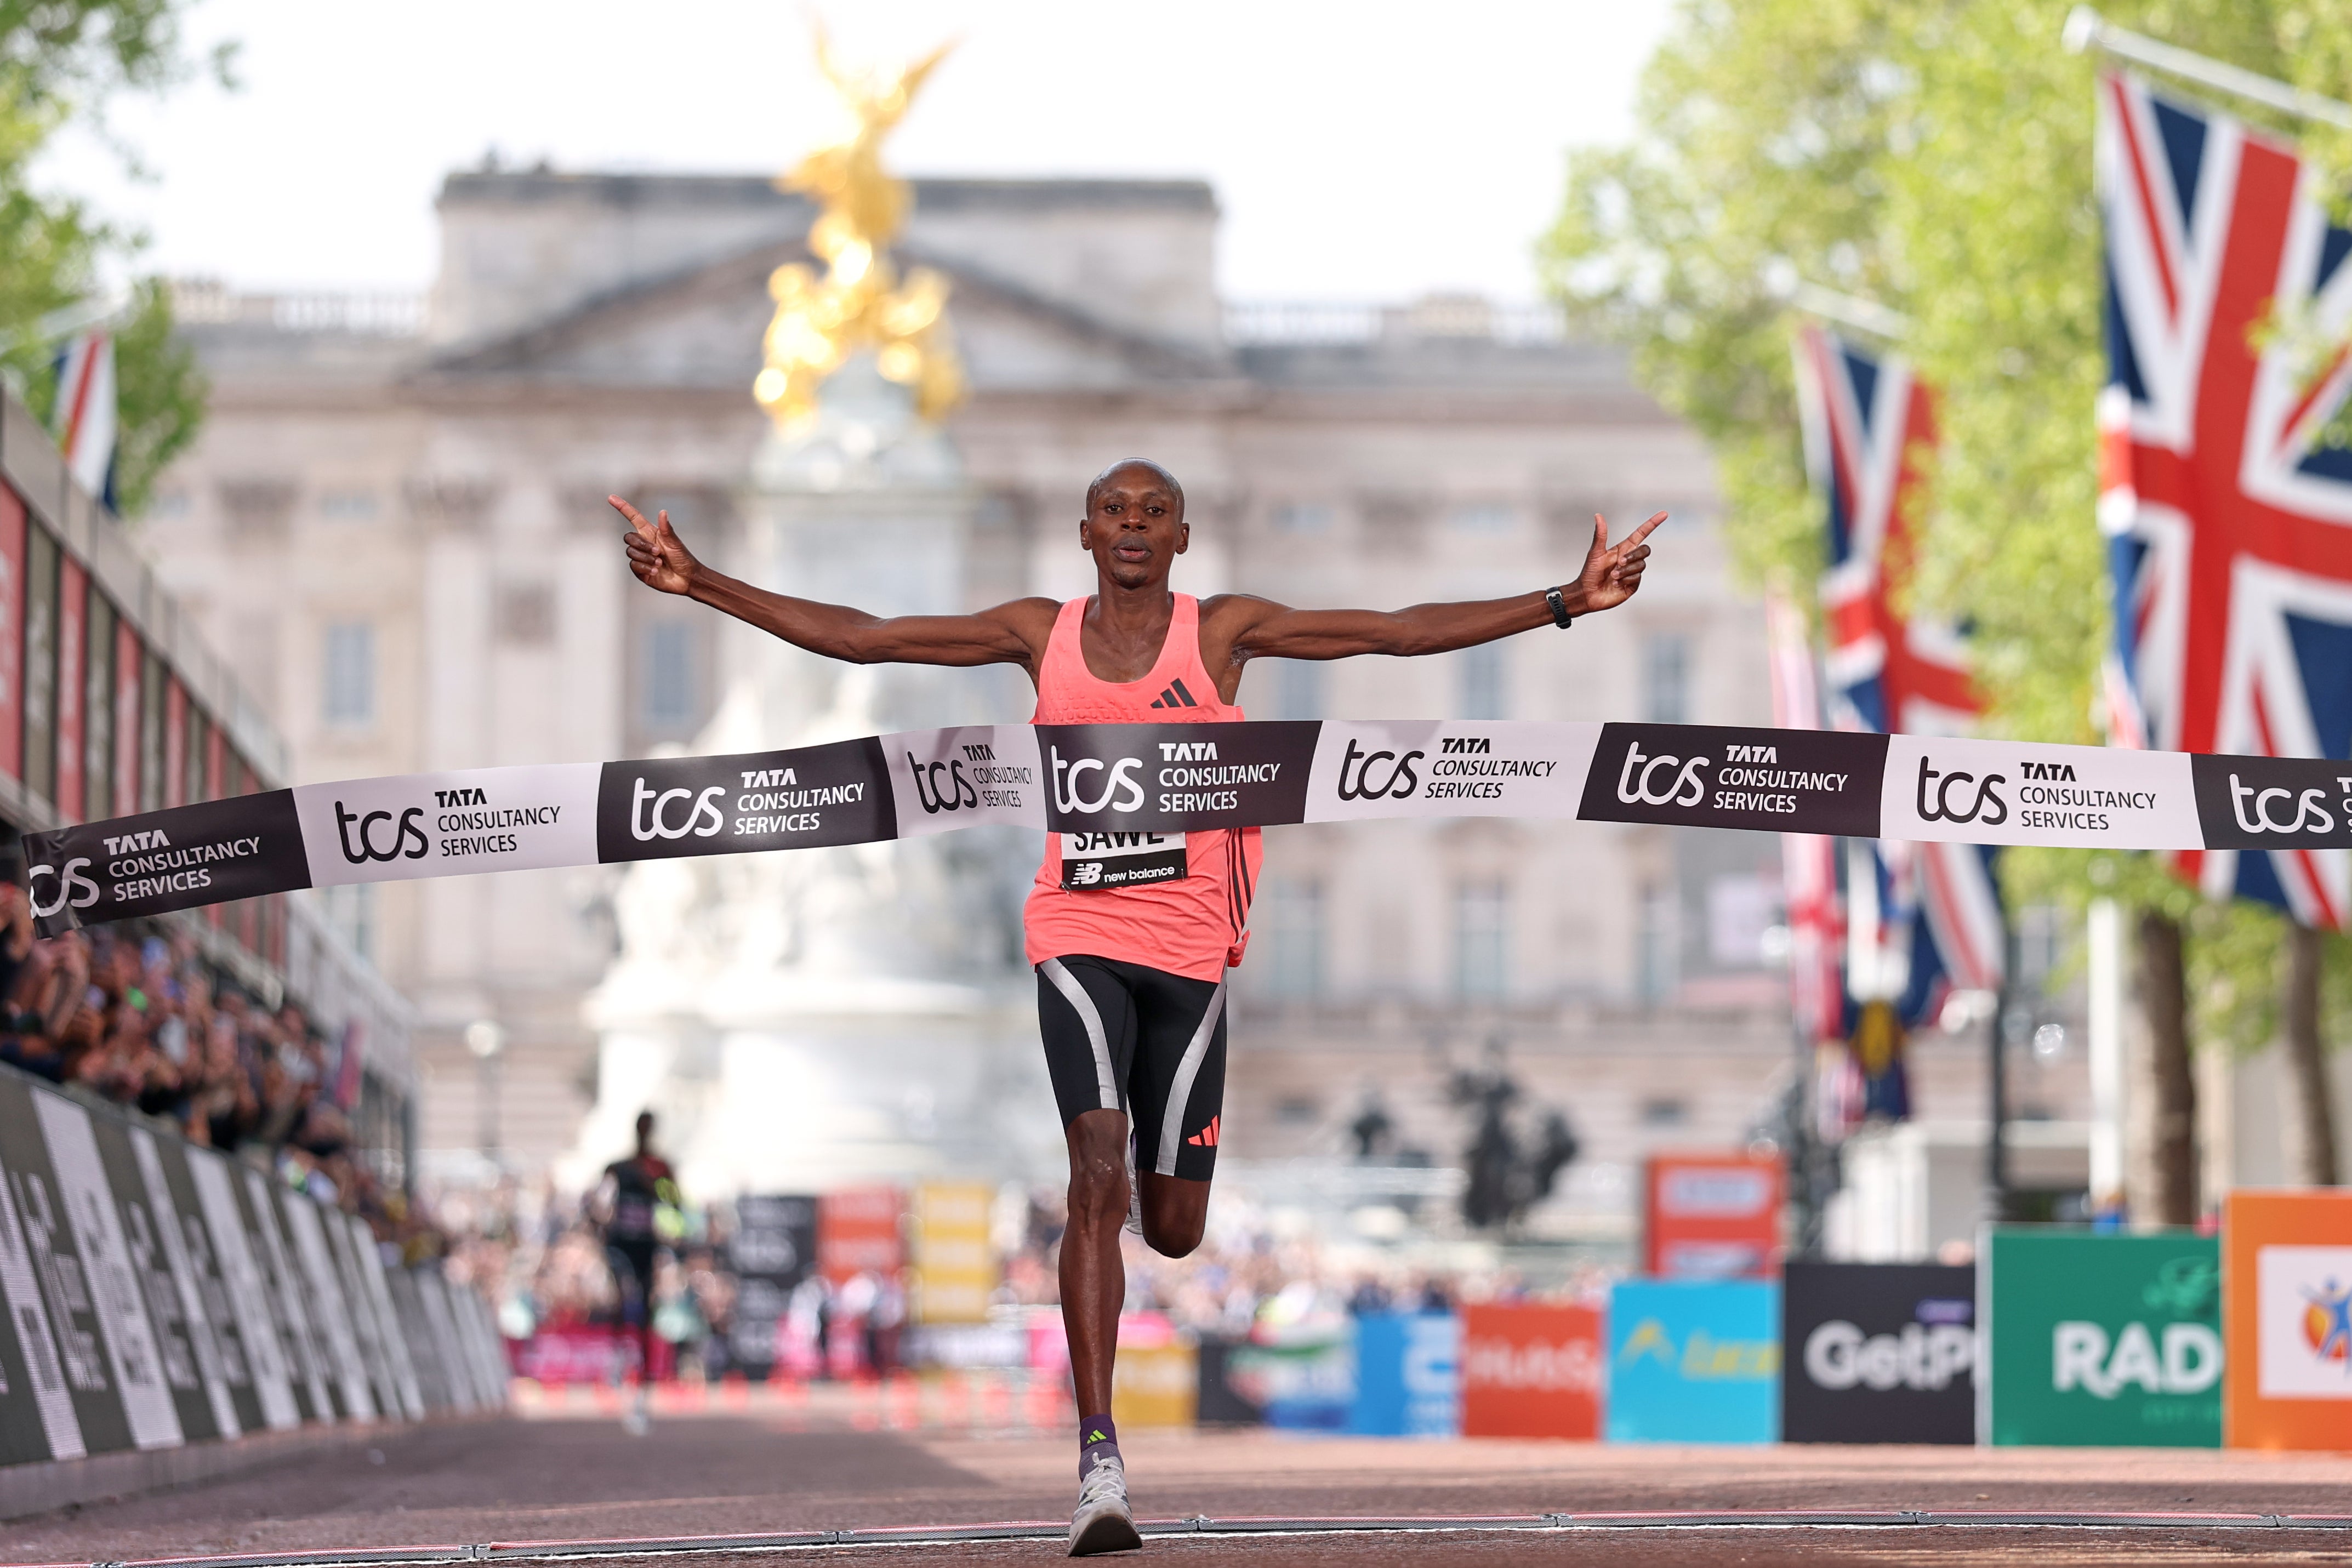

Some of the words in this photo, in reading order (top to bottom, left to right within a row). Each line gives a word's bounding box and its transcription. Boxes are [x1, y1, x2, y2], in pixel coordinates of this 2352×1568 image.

[962, 744, 996, 761] TATA
[1159, 742, 1218, 761] TATA
[1442, 738, 1490, 754] TATA
[1726, 745, 1777, 764] TATA
[741, 768, 797, 789] TATA
[973, 767, 1032, 785] CONSULTANCY
[1051, 745, 1144, 814] tcs
[1159, 763, 1281, 787] CONSULTANCY
[1337, 738, 1425, 801] tcs
[1433, 760, 1557, 777] CONSULTANCY
[1617, 741, 1710, 807] tcs
[1718, 767, 1848, 792] CONSULTANCY
[2020, 762, 2076, 782] TATA
[907, 751, 977, 814] tcs
[1425, 782, 1504, 799] SERVICES
[1917, 755, 2008, 825] tcs
[434, 788, 487, 808] TATA
[737, 782, 864, 812] CONSULTANCY
[982, 790, 1022, 808] SERVICES
[1159, 790, 1238, 812] SERVICES
[1713, 791, 1797, 813] SERVICES
[2020, 786, 2156, 809] CONSULTANCY
[2229, 773, 2334, 834] tcs
[437, 806, 561, 833] CONSULTANCY
[631, 777, 726, 841] tcs
[2021, 810, 2109, 830] SERVICES
[334, 801, 429, 864] tcs
[734, 812, 820, 835] SERVICES
[103, 829, 170, 856] TATA
[441, 834, 517, 857] SERVICES
[109, 836, 260, 877] CONSULTANCY
[113, 868, 212, 902] SERVICES
[1104, 872, 1127, 883] new
[1129, 866, 1175, 880] balance
